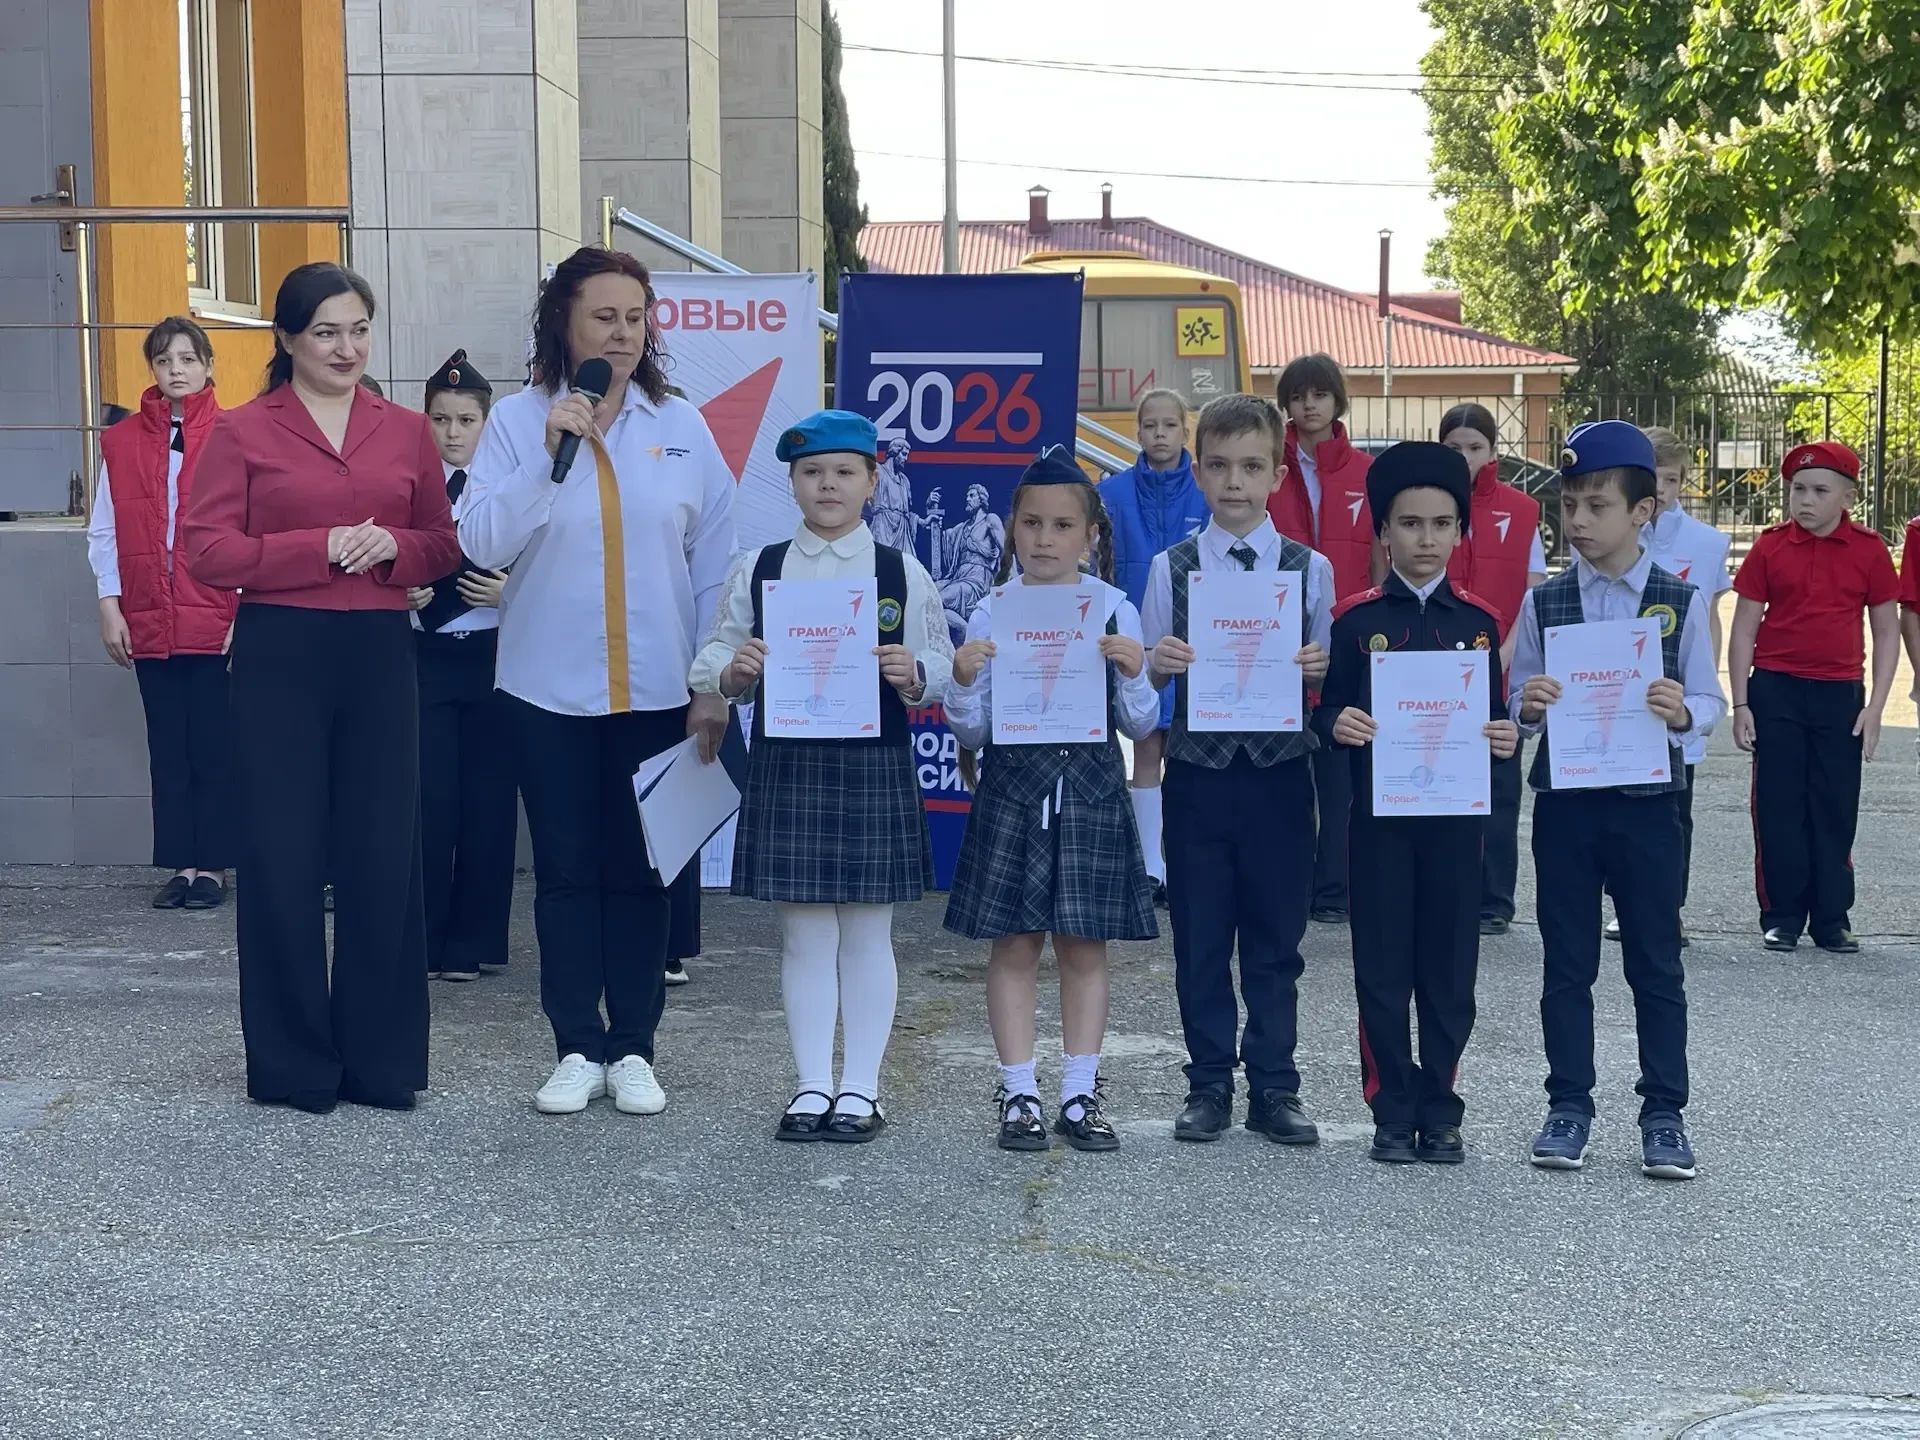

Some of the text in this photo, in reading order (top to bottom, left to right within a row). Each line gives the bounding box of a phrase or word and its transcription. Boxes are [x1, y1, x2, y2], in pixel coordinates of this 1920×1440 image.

[652, 297, 787, 332] рвые
[1080, 367, 1156, 402] ЕТИ
[867, 371, 1042, 444] 2026
[1196, 710, 1233, 720] Первые
[773, 717, 811, 727] Первые
[1001, 723, 1038, 734] Первые
[1559, 766, 1598, 777] Первые
[1382, 794, 1420, 805] Первые
